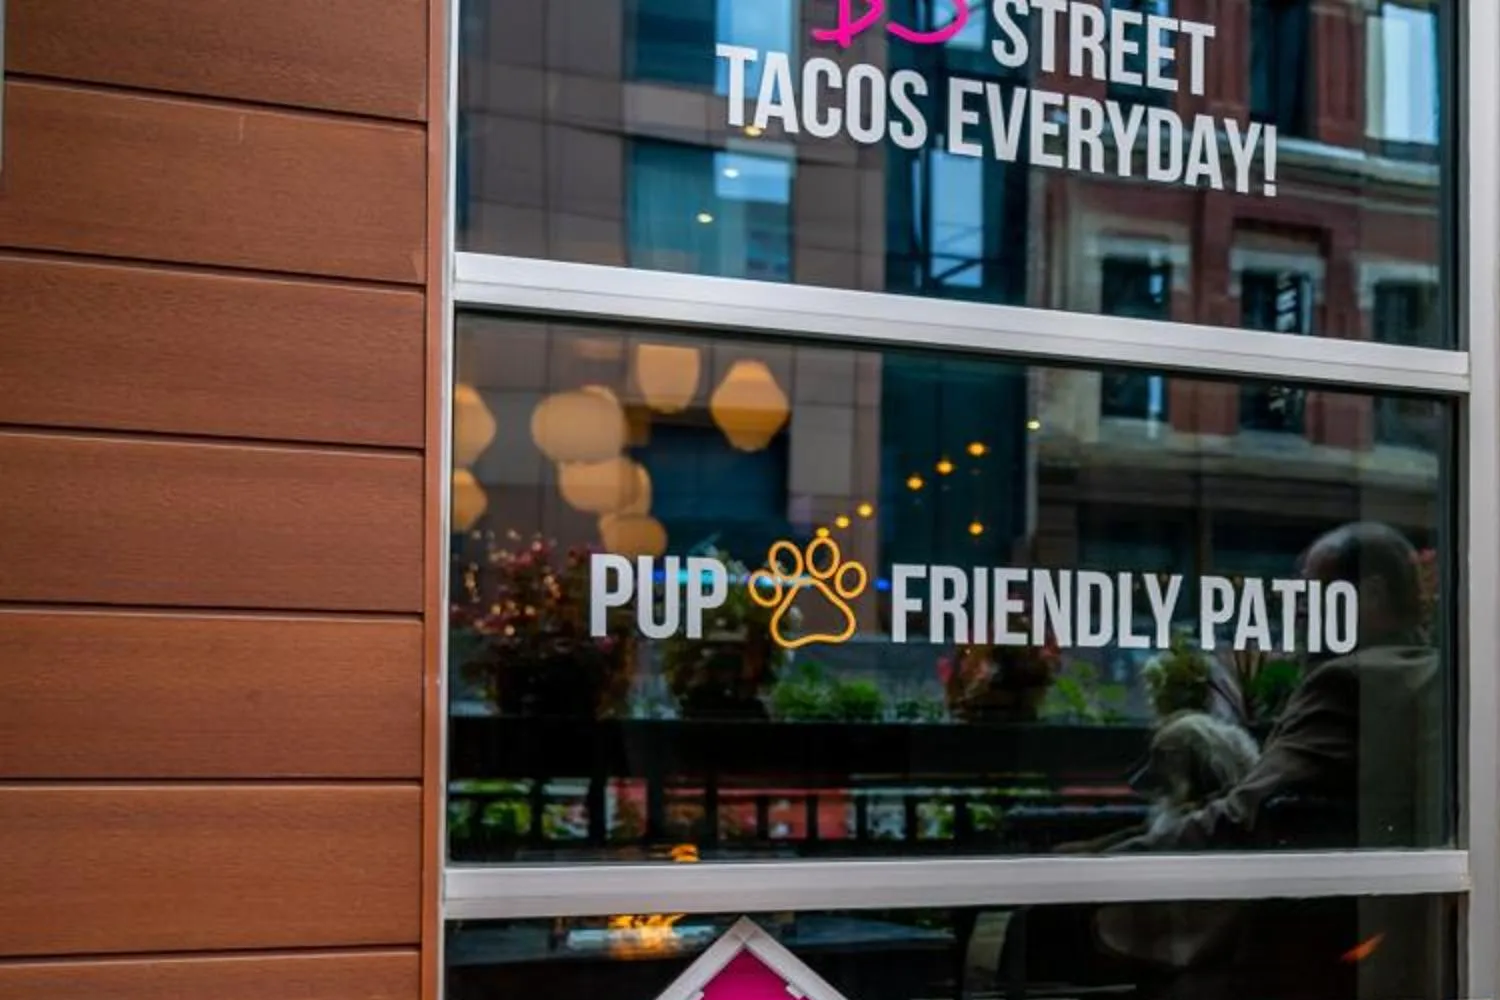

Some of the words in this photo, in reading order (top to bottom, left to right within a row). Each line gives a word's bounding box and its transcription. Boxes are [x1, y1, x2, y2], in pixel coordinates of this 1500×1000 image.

[991, 0, 1216, 96] STREET
[715, 43, 928, 149] TACOS
[948, 76, 1278, 197] EVERYDAY!
[590, 553, 728, 639] PUP
[891, 563, 1182, 649] FRIENDLY
[1199, 575, 1359, 654] PATIO
